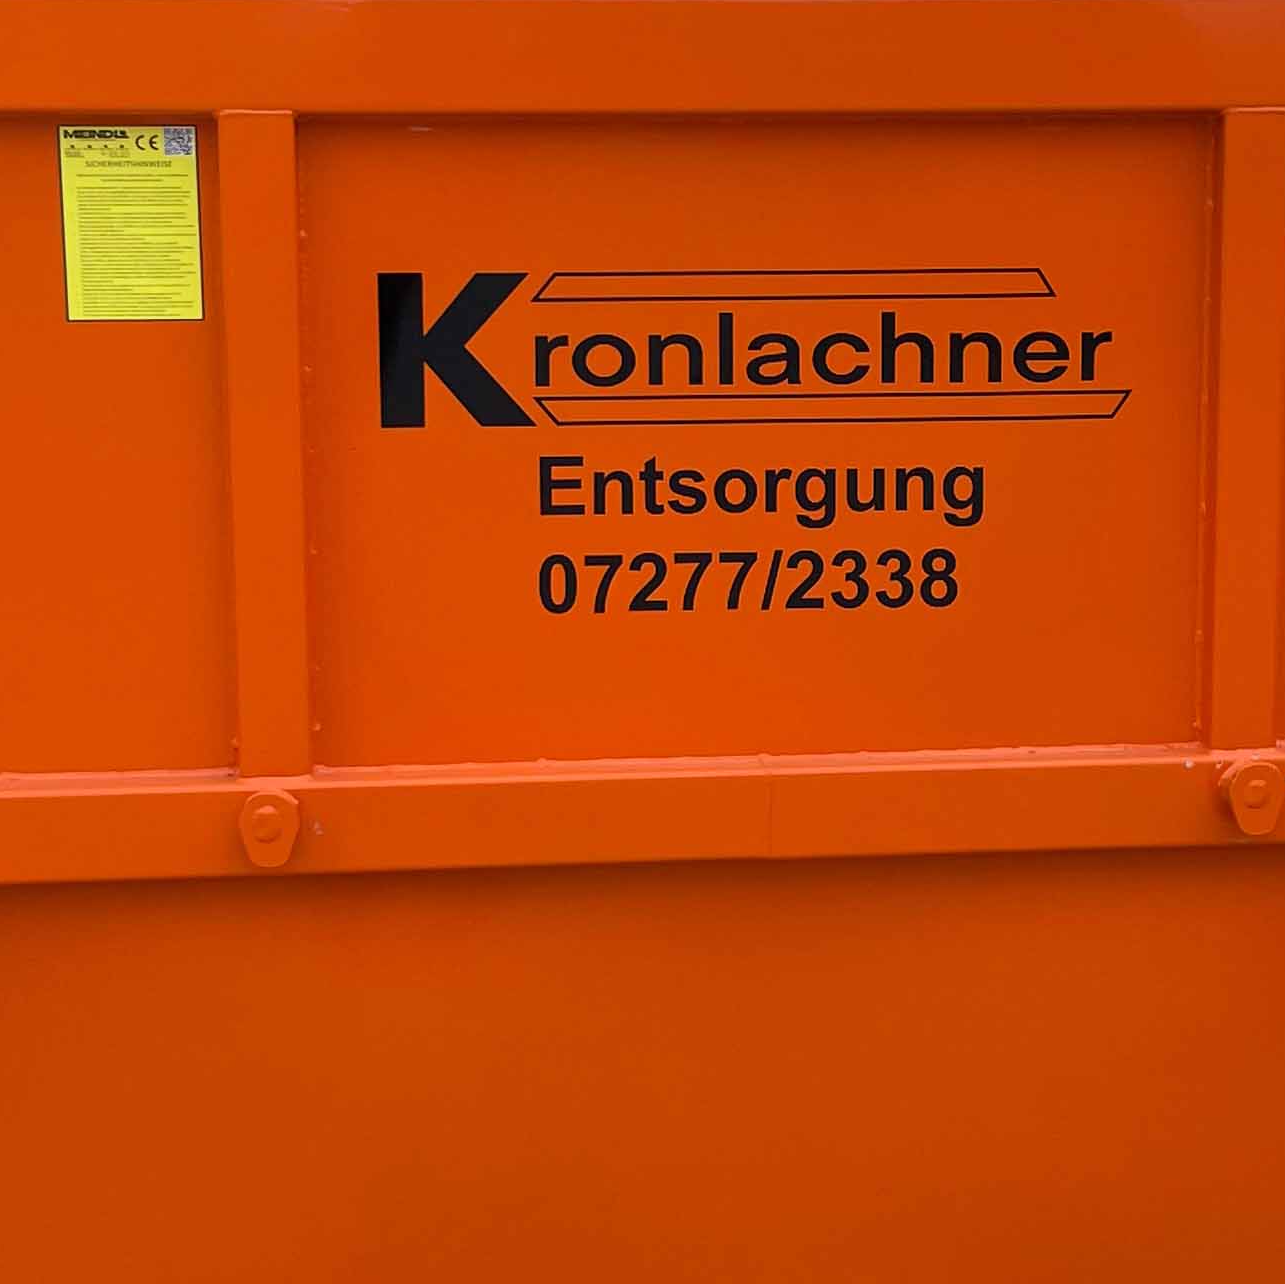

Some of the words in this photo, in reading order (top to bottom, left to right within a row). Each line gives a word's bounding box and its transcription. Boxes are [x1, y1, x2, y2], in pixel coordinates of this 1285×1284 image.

[377, 271, 1113, 429] Kronlachner
[538, 454, 985, 528] Entsorgung
[538, 548, 959, 614] 07277/2338
